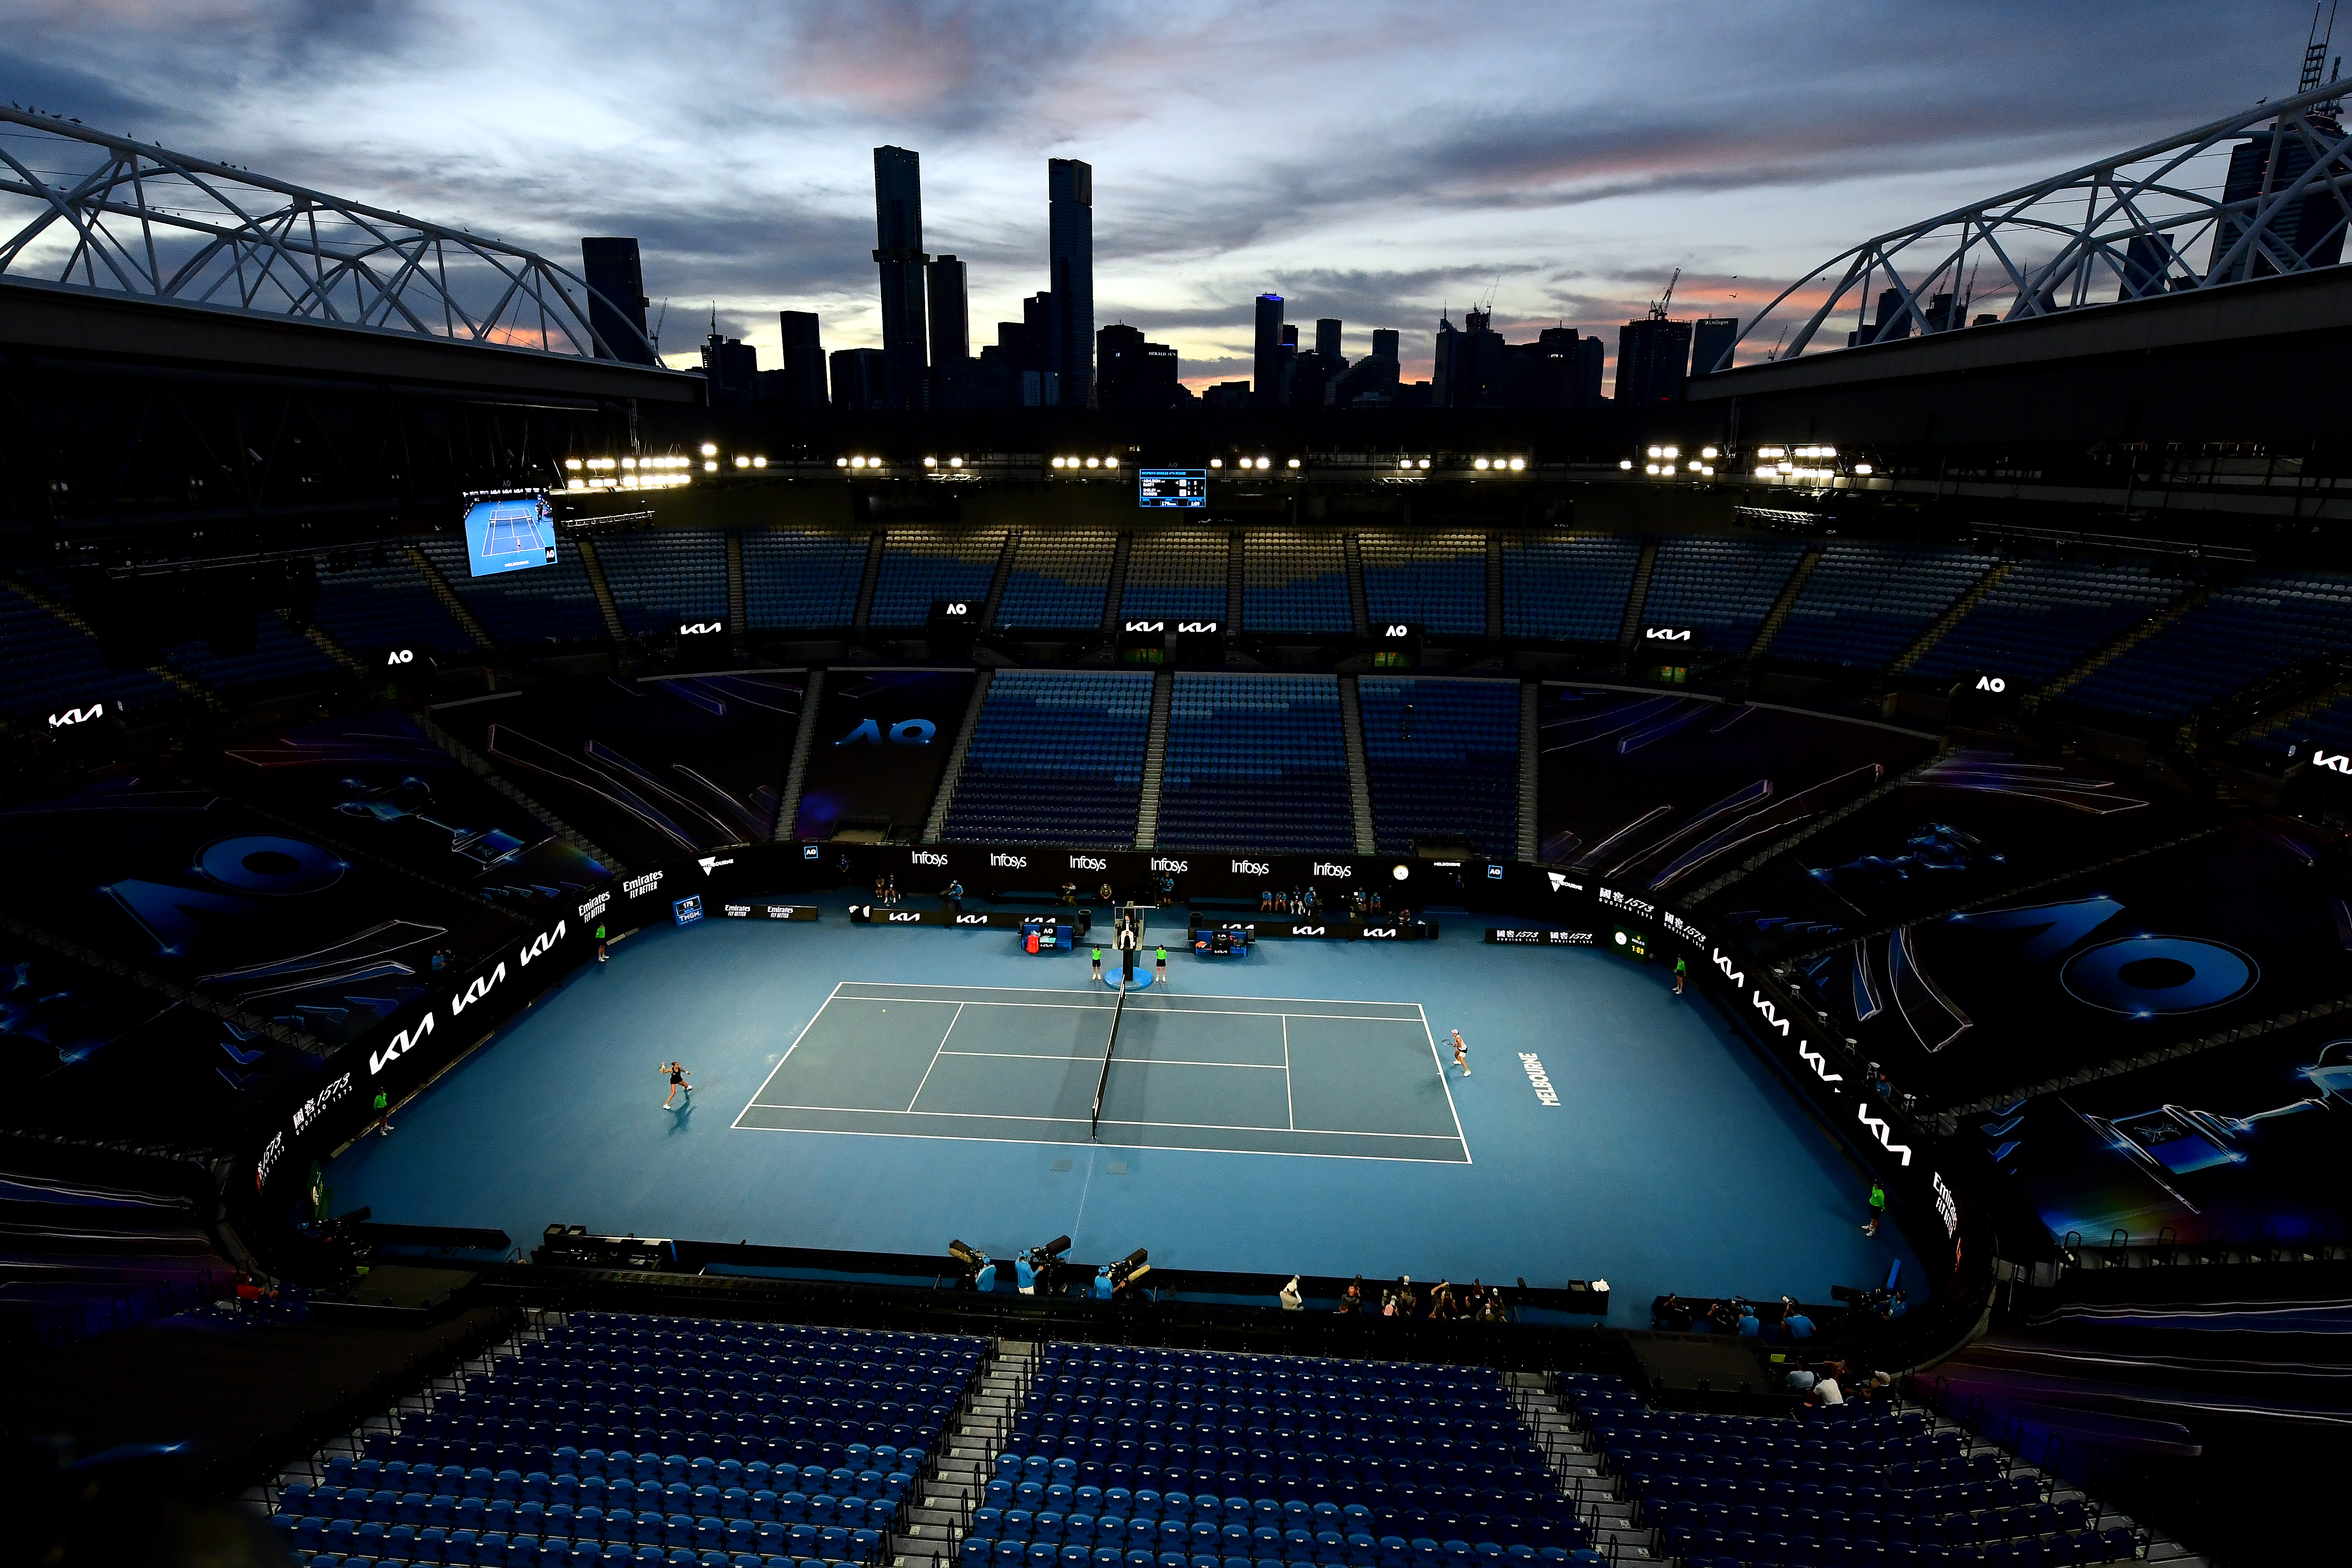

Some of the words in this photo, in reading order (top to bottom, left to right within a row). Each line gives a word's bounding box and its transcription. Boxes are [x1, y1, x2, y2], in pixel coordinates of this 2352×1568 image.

[947, 603, 966, 614] AO
[1386, 625, 1407, 636] AO
[387, 649, 413, 665] AO
[1975, 676, 2005, 693] AO
[835, 718, 936, 746] AO
[912, 851, 948, 867] Infosys
[991, 853, 1027, 869] Infosys
[1070, 856, 1106, 871] Infosys
[1151, 858, 1188, 873] Infosys
[1232, 860, 1269, 876] Infosys
[1314, 862, 1351, 878] Infosys
[623, 871, 663, 893] Emirates
[630, 888, 638, 899] FLY
[639, 881, 657, 896] BETTER
[579, 892, 610, 917] Emirates
[584, 911, 592, 923] FLY
[592, 903, 606, 919] BETTER
[1631, 938, 1645, 946] ROLEX
[1632, 945, 1644, 955] 1:09
[1518, 1052, 1561, 1106] MELBOURNE
[296, 1104, 326, 1136] GUOJIAO
[333, 1086, 352, 1102] 1573
[1936, 1197, 1946, 1215] FLY
